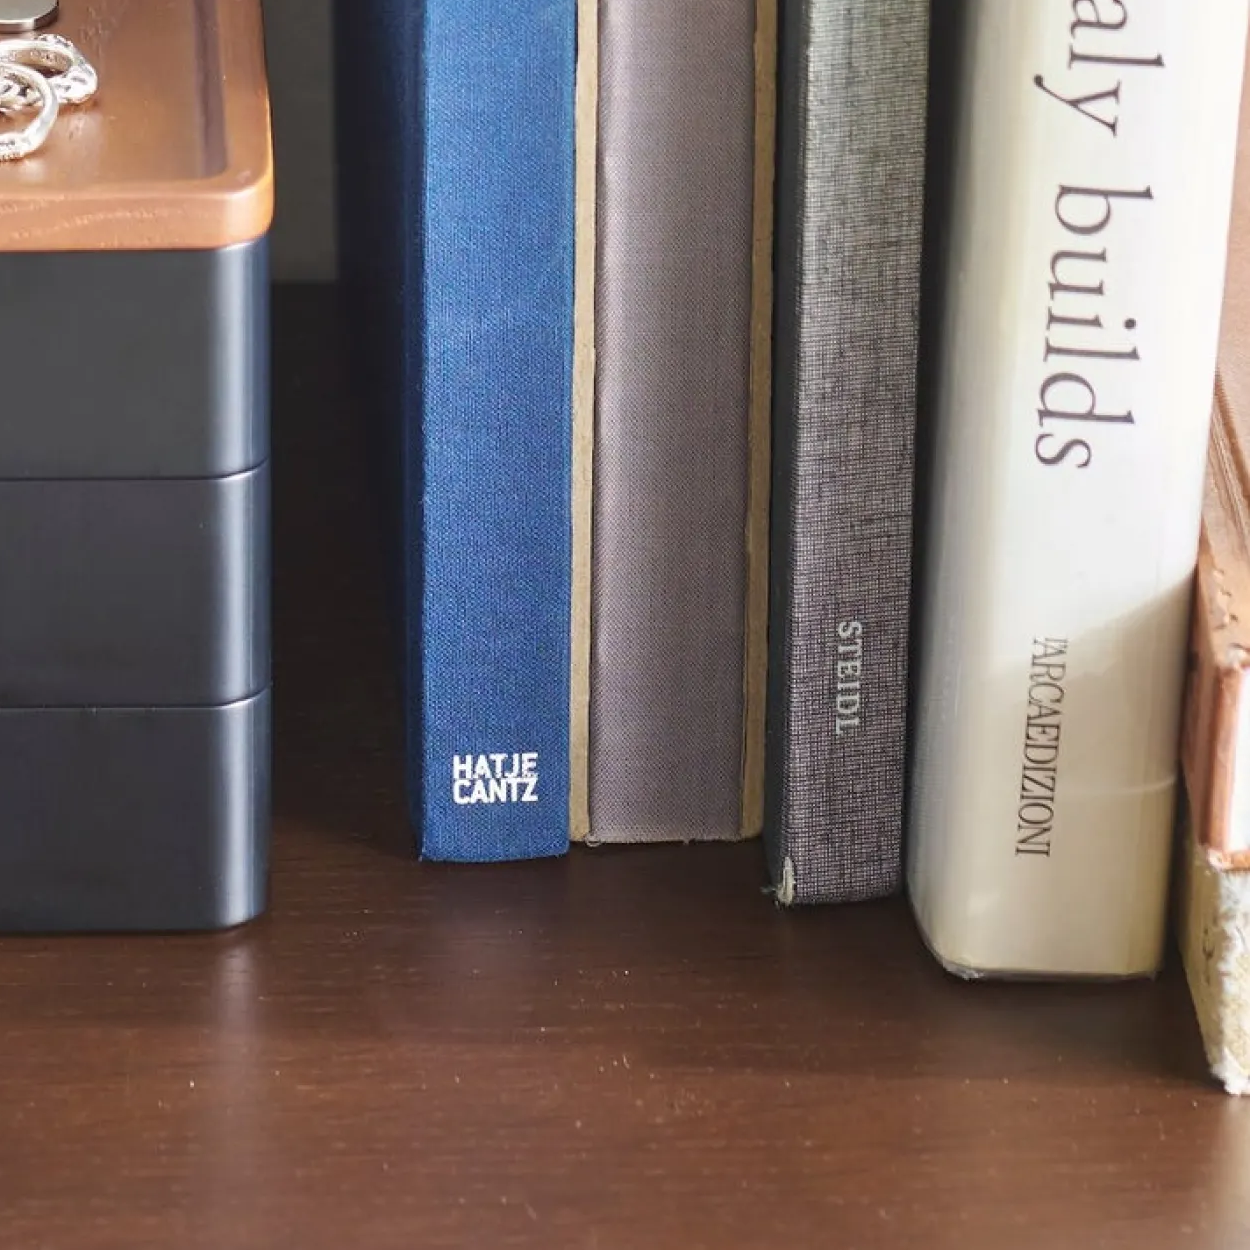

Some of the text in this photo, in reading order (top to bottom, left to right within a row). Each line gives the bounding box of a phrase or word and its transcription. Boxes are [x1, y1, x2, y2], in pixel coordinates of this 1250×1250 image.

[1034, 183, 1155, 470] builds
[834, 619, 864, 737] STEIDL
[452, 752, 539, 779] HATJE
[452, 777, 539, 805] CANTZ
